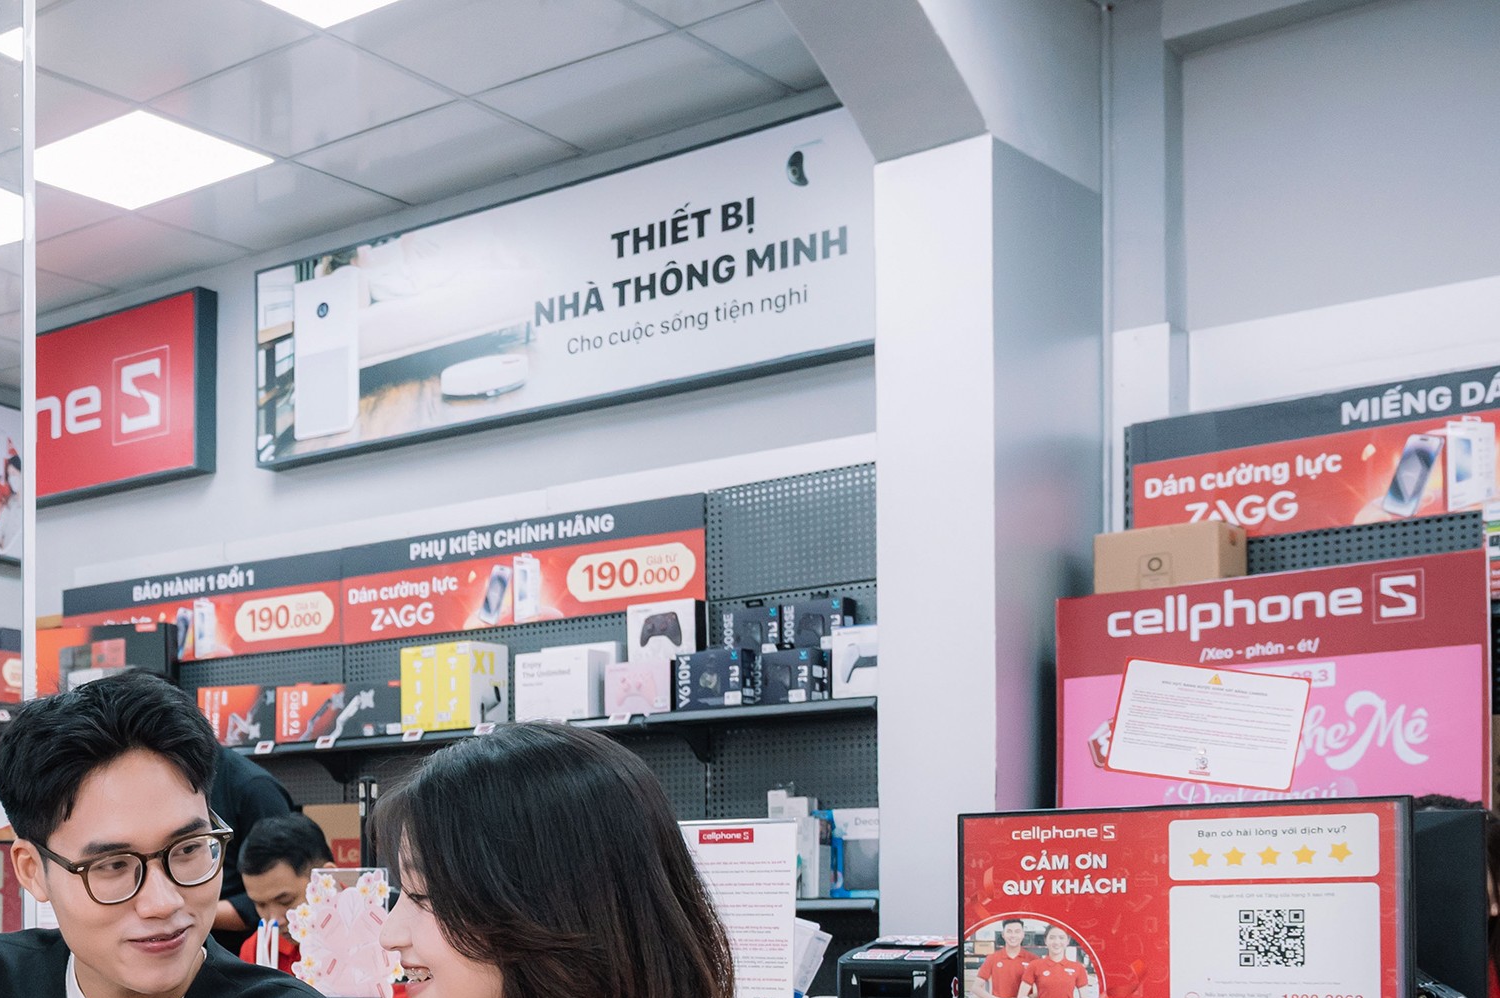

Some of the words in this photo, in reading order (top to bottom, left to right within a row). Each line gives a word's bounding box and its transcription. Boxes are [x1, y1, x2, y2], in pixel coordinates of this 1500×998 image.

[611, 202, 711, 259] THIẾT
[720, 197, 755, 234] BỊ
[534, 281, 605, 327] NHÀ
[612, 254, 736, 307] THÔNG
[745, 225, 848, 278] MINH
[567, 334, 603, 355] Cho
[608, 321, 654, 345] cuộc
[660, 309, 709, 331] sống
[715, 300, 754, 322] tiện
[760, 284, 808, 314] nghi
[1341, 384, 1452, 426] MIẾNG
[1144, 473, 1195, 499] Dán
[1200, 462, 1290, 492] cường
[1295, 453, 1342, 480] lực
[1184, 490, 1299, 527] ZAGG
[409, 539, 447, 562] PHỤ
[450, 531, 492, 557] KIỆN
[493, 521, 555, 549] CHÍNH
[558, 513, 615, 539] HÃNG
[132, 581, 162, 602] BẢO
[163, 577, 206, 598] HÀNH
[217, 565, 245, 589] ĐỔI
[348, 586, 378, 605] Dán
[379, 576, 430, 601] cường
[432, 574, 458, 594] lực
[583, 557, 680, 592] 190.000
[247, 605, 322, 633] 190.000
[371, 602, 435, 632] ZAGG
[1107, 586, 1363, 642] cellphone
[473, 650, 495, 674] X1
[702, 832, 742, 842] cellphone
[1011, 826, 1098, 843] cellphone
[1020, 850, 1070, 872] CẢM
[1075, 853, 1108, 870] ƠN
[1002, 875, 1046, 897] QUÝ
[1051, 875, 1127, 895] KHÁCH
